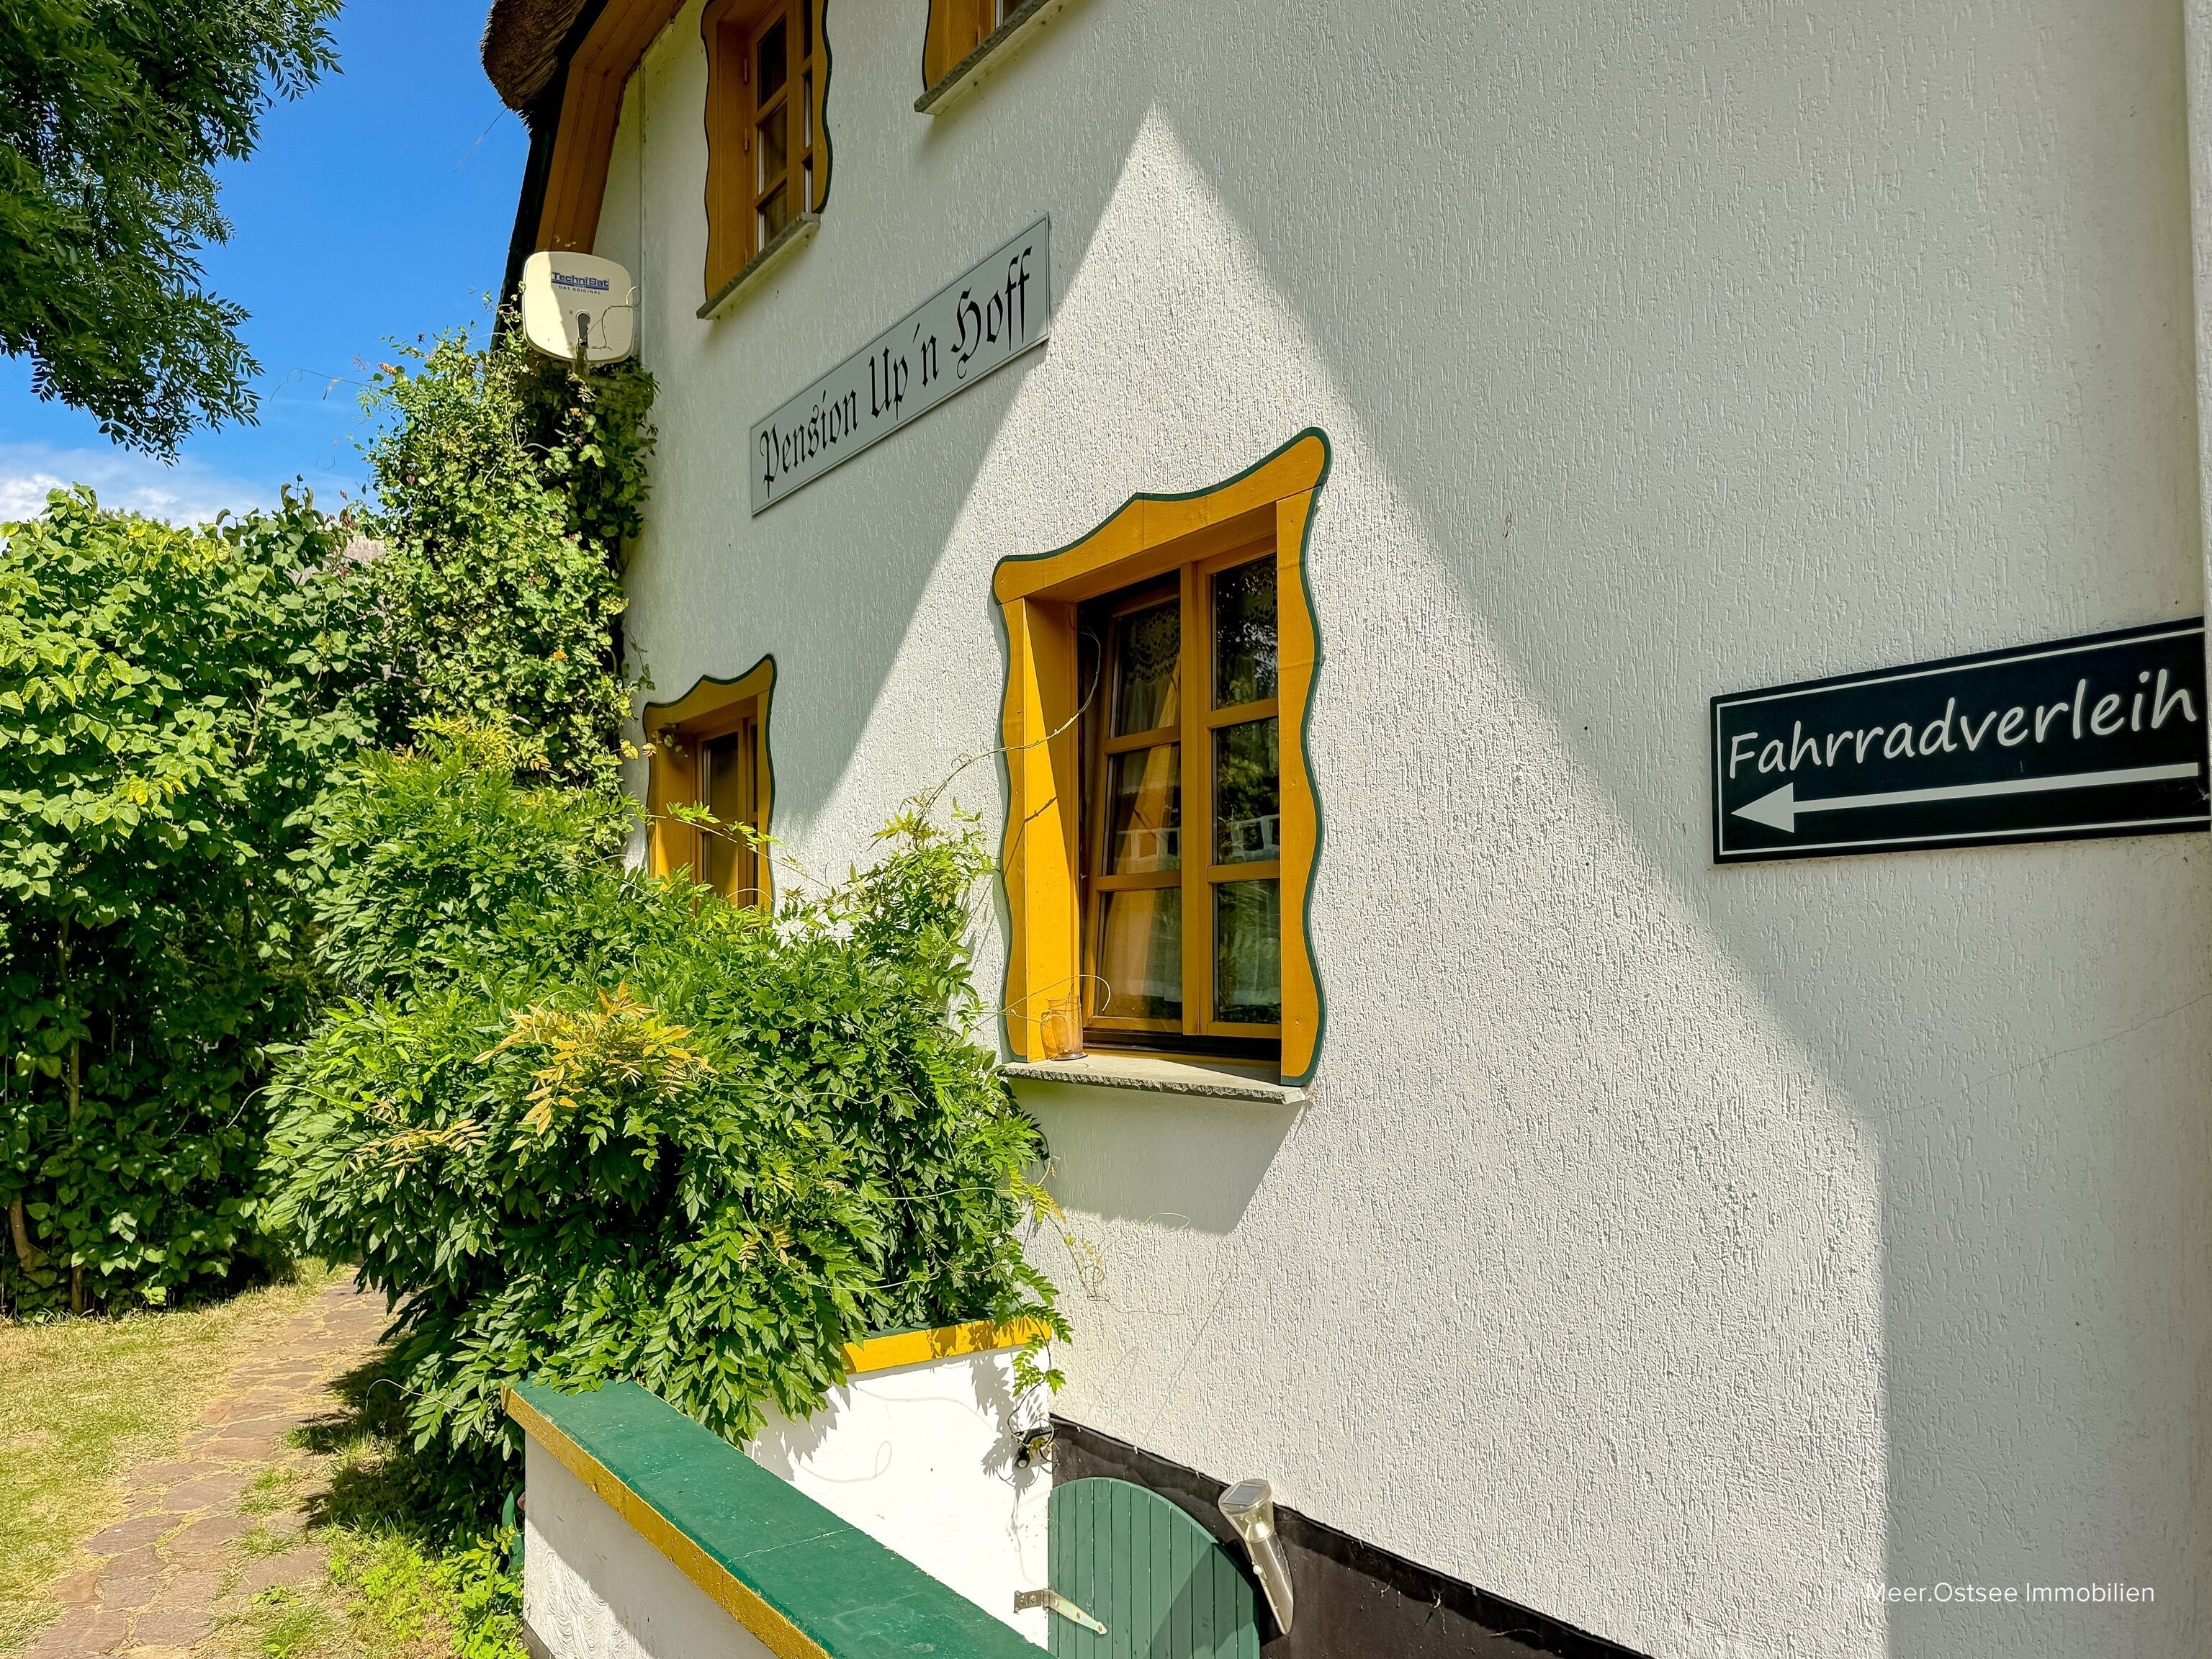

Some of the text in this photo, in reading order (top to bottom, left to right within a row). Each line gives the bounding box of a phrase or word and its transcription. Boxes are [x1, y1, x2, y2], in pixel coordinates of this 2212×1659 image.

[552, 272, 608, 287] TechniSat
[760, 390, 858, 498] Pension
[950, 246, 1032, 379] Hoff
[1729, 669, 2196, 779] Fahrradverleih
